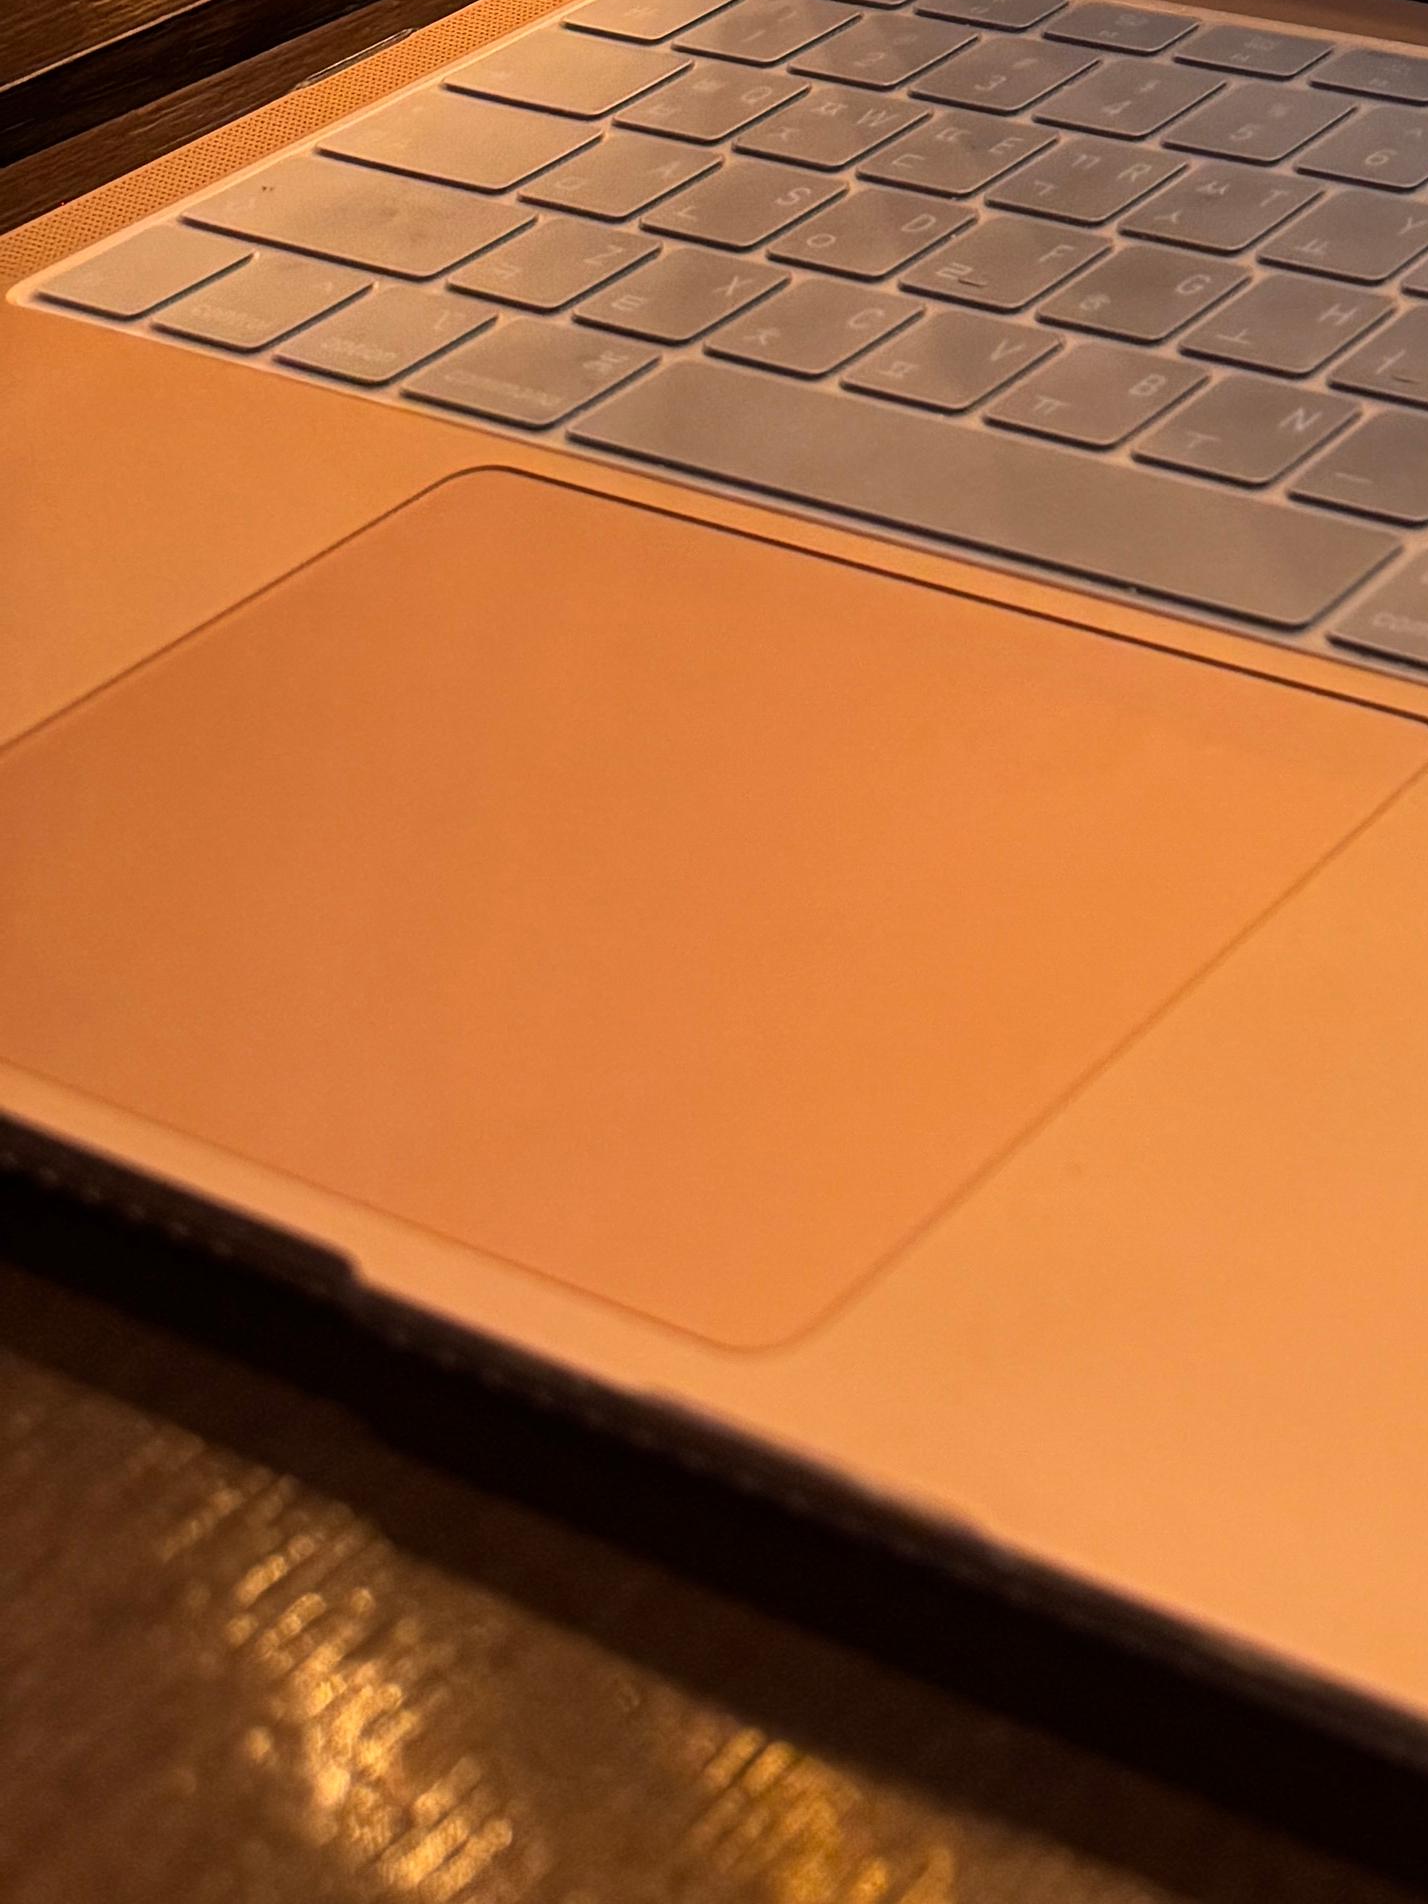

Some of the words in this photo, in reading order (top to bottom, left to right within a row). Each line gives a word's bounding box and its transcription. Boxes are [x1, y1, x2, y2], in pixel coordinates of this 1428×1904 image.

[973, 73, 1008, 92] 3
[740, 85, 772, 106] Q
[988, 136, 1024, 155] E
[1364, 148, 1394, 167] 6
[1117, 162, 1153, 183] R
[775, 187, 811, 206] S
[901, 213, 937, 233] D
[1038, 243, 1075, 263] F
[1174, 274, 1212, 297] G
[848, 309, 886, 330] C
[1317, 303, 1360, 327] H
[989, 337, 1027, 363] V
[1127, 372, 1168, 397] B
[1278, 406, 1322, 432] N
